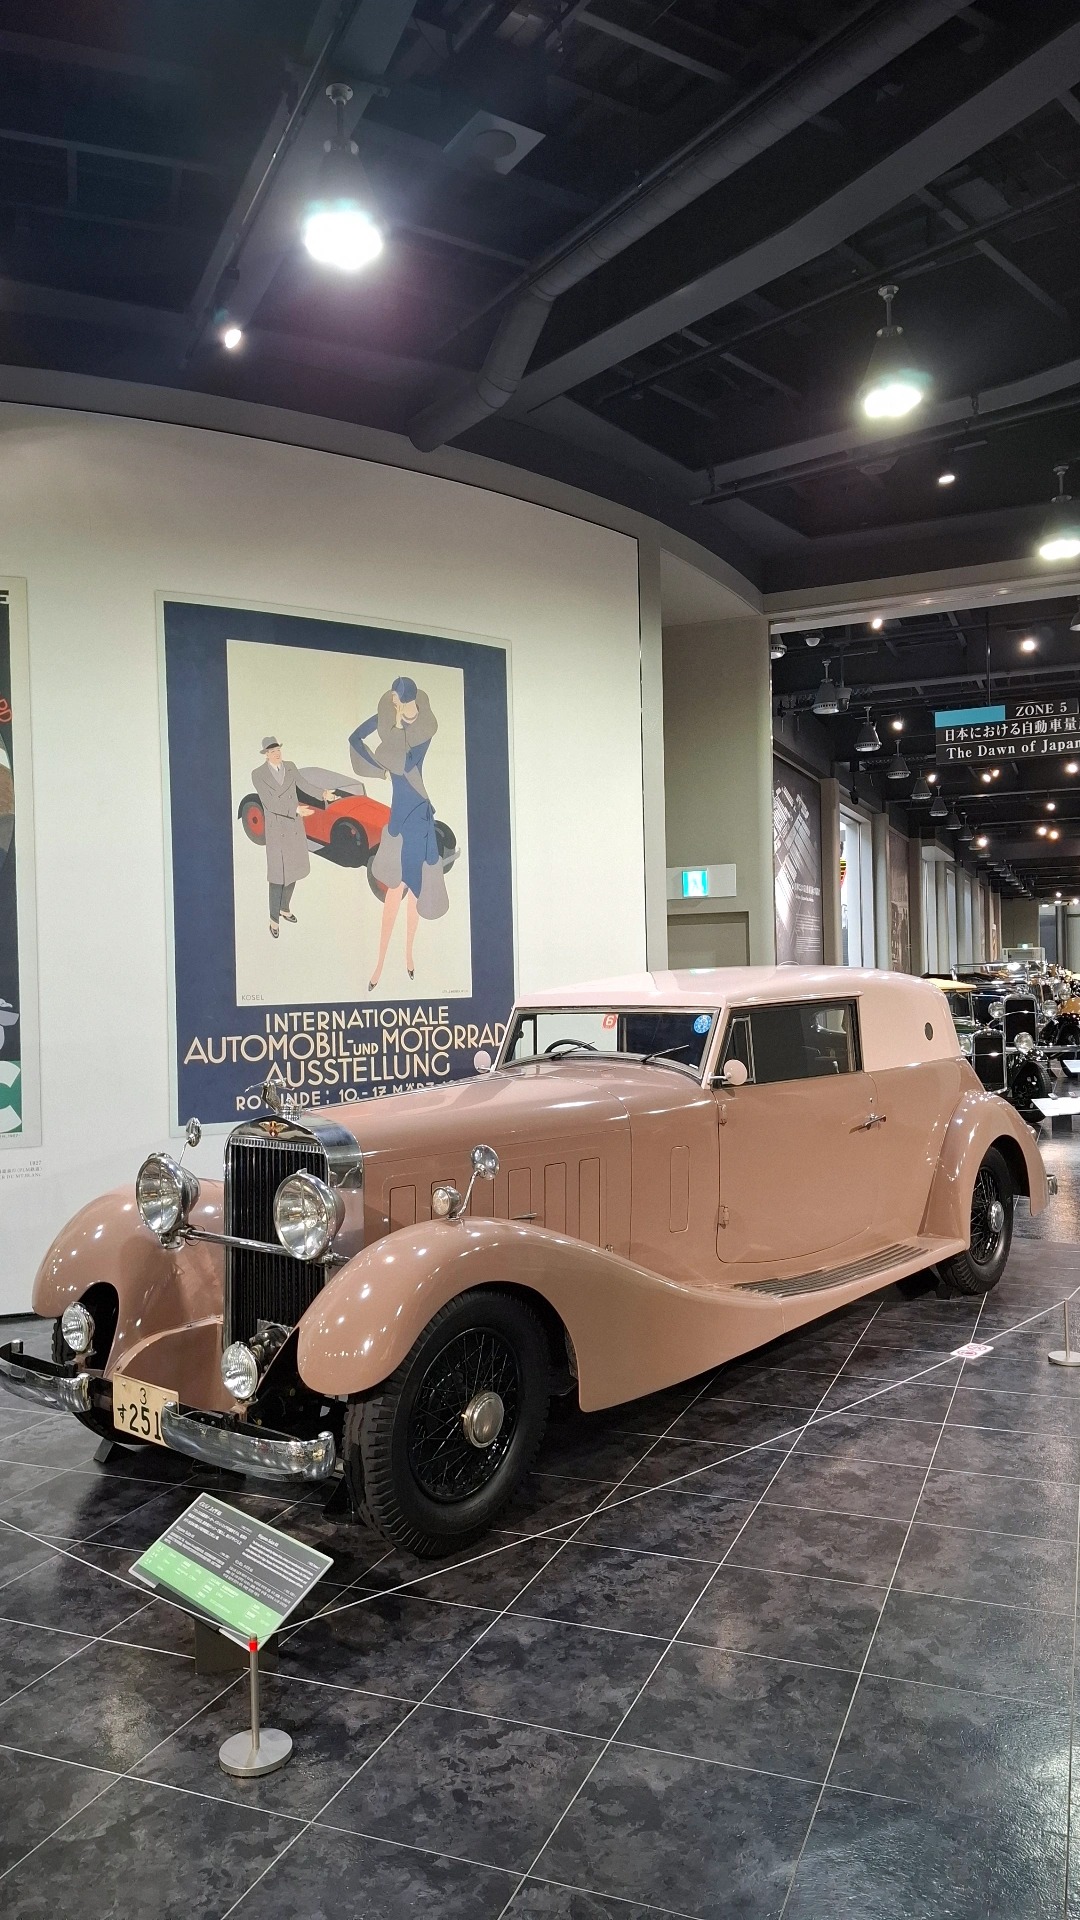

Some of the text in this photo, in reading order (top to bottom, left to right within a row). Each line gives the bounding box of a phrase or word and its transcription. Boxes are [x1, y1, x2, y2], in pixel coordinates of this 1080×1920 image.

[1015, 702, 1067, 717] ZONE 5
[945, 716, 1080, 742] 日本における自動車量
[946, 747, 972, 760] The
[978, 744, 1016, 757] Dawn
[1021, 740, 1036, 753] of
[265, 1004, 450, 1033] INTERNATIONALE
[382, 1022, 506, 1054] MOTORRAD
[265, 1051, 450, 1088] AUSSTELLUNG
[140, 1387, 147, 1405] 3
